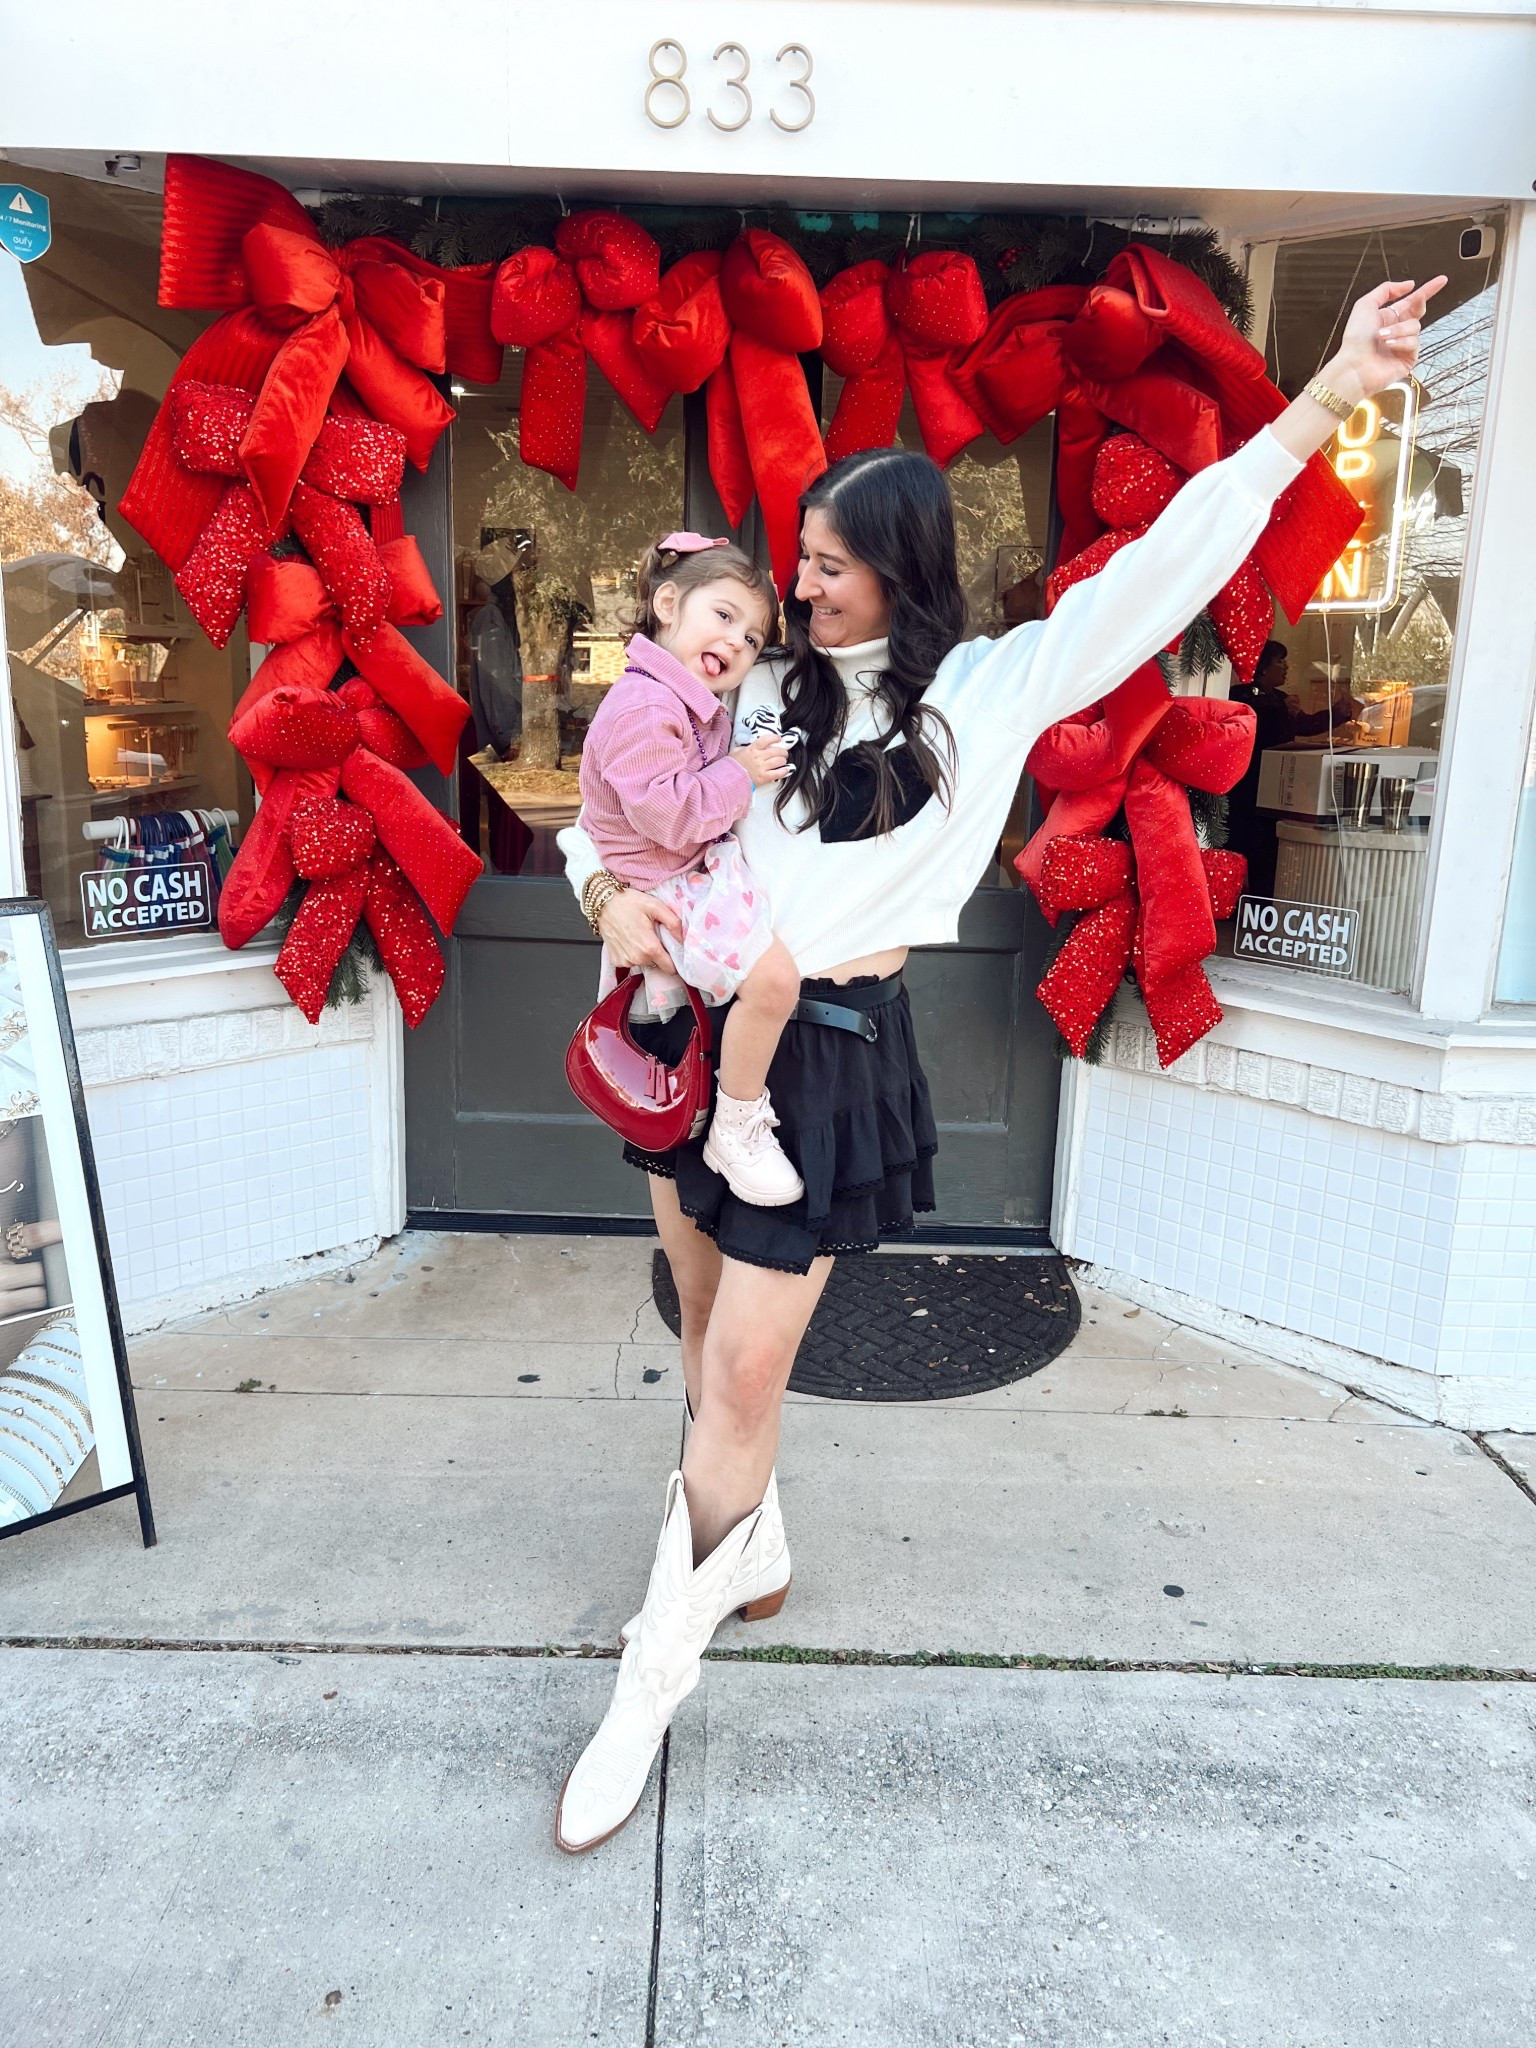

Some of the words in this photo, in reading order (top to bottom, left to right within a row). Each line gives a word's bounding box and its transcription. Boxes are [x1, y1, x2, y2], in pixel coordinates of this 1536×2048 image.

[644, 37, 816, 133] 833
[12, 217, 47, 232] Monitoring
[12, 236, 33, 248] eufy
[1321, 399, 1379, 598] OPN
[86, 877, 128, 908] NO
[133, 870, 202, 903] CASH
[91, 900, 205, 930] ACCEPTED
[1242, 902, 1279, 933] NO
[1283, 909, 1350, 945] CASH
[1239, 932, 1348, 966] ACCEPTED
